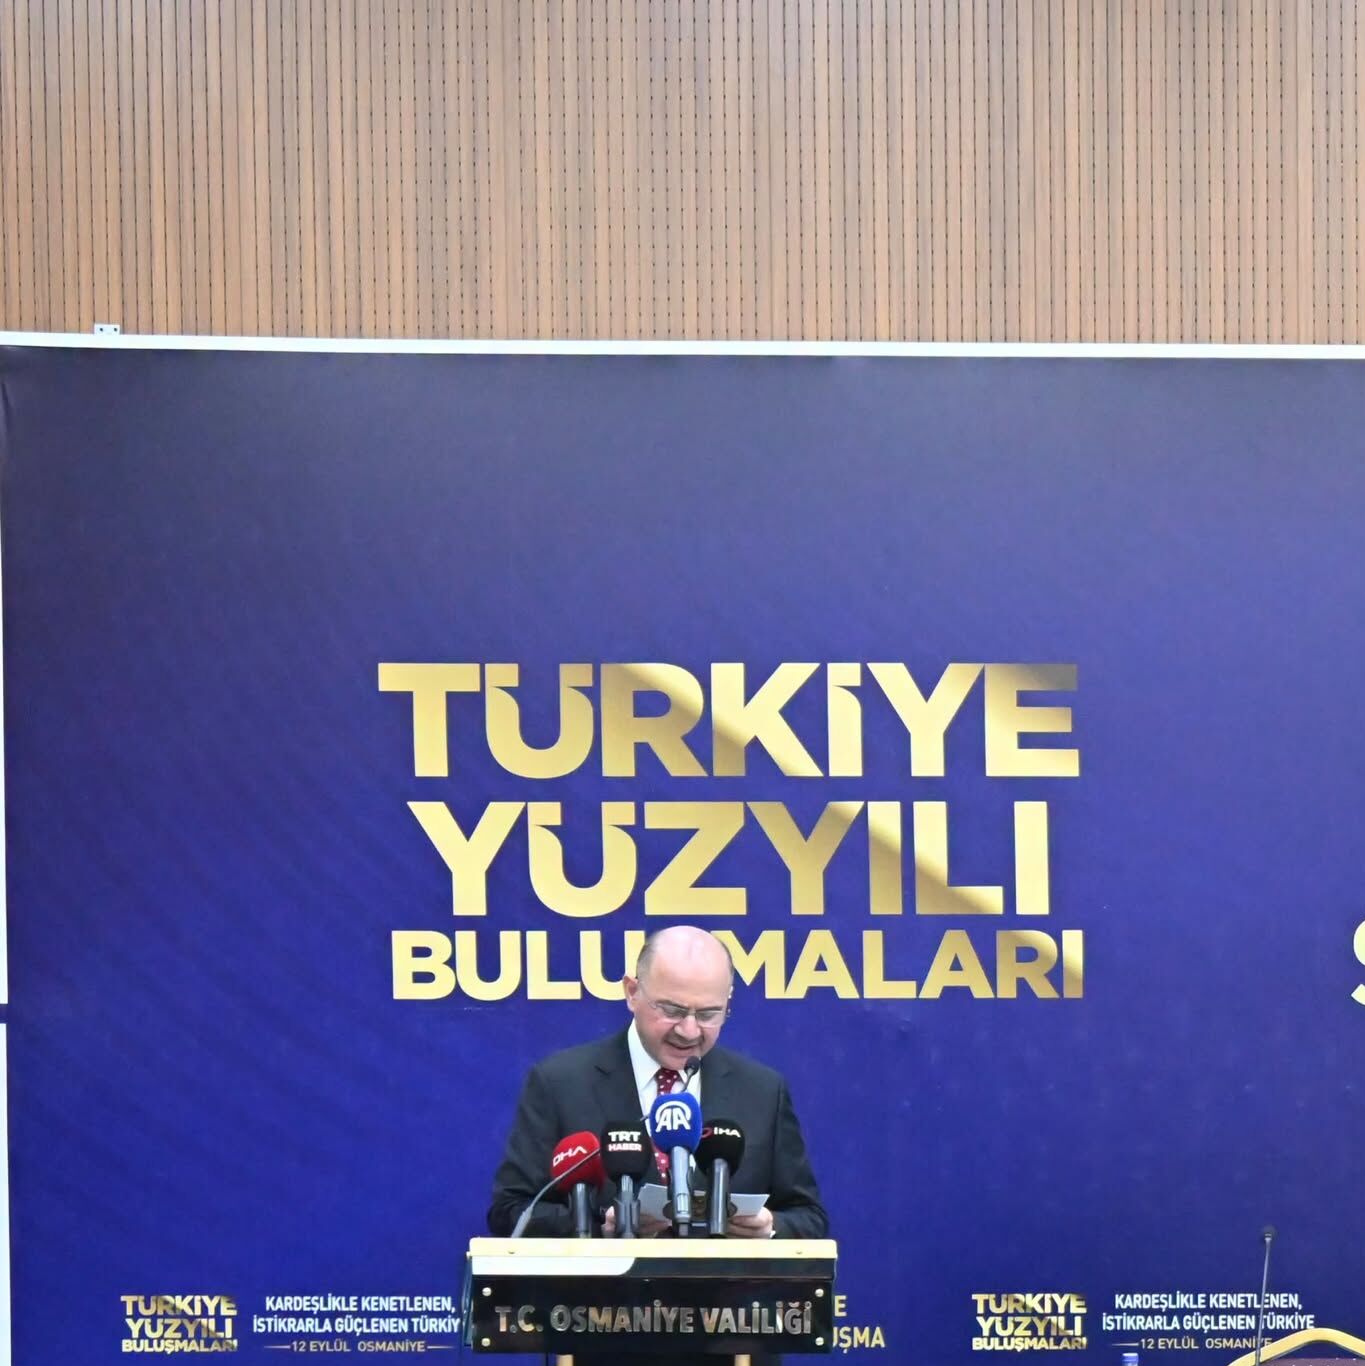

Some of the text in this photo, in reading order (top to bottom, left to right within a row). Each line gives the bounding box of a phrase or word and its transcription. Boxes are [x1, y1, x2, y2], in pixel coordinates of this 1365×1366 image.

[391, 929, 1084, 1001] BULUMALARI
[656, 1107, 691, 1132] AA
[608, 1131, 641, 1142] TRT
[608, 1143, 642, 1152] HABER
[265, 1292, 456, 1315] KARDEŞLİKLE KENETLENEN,
[1114, 1290, 1303, 1314] KARDEŞLİKLE KENETLENEN,
[252, 1314, 461, 1337] İSTİKRARLA GÜÇLENEN TÜRKİY
[495, 1299, 812, 1335] T.C. OSMANİYE VALİLİĞİ
[1102, 1311, 1315, 1334] İSTİKRARLA GÜÇLENEN TÜRKİYE
[291, 1338, 426, 1353] 12 EYLÜL OSMANİYE
